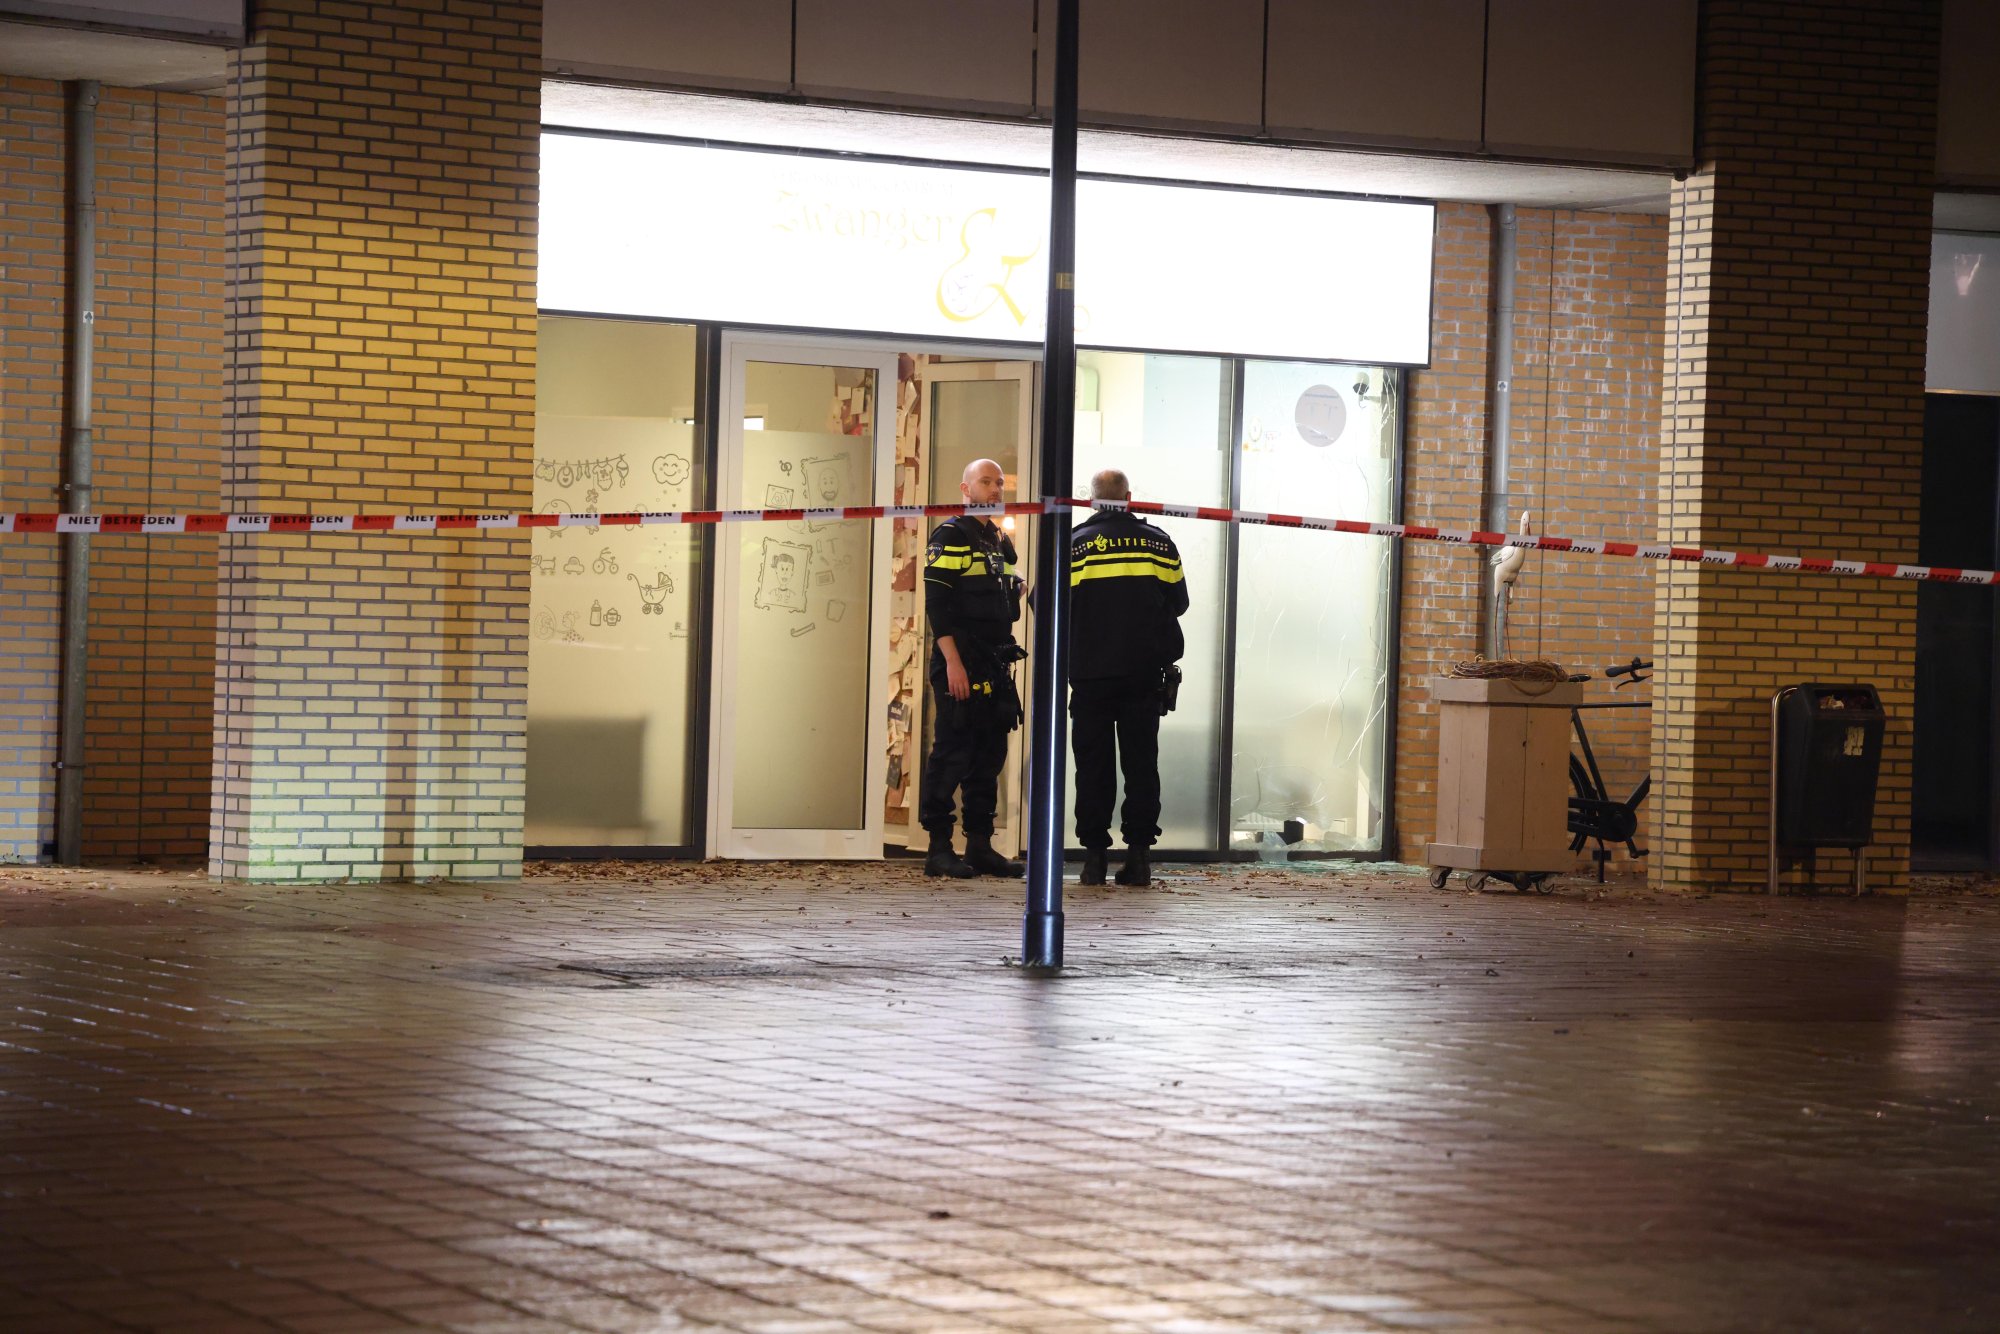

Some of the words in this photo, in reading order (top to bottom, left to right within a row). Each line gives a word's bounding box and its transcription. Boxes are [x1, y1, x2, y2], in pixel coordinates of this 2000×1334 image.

[1100, 504, 1127, 512] NIET
[68, 516, 99, 525] NIET
[104, 516, 175, 525] BETREDEN
[238, 516, 268, 524] NIET
[273, 516, 344, 524] BETREDEN
[1376, 529, 1402, 537] NIET
[1404, 532, 1462, 542] BETREDEN
[1087, 534, 1147, 551] POLITIE
[1510, 541, 1536, 549] NIET
[1539, 543, 1595, 554] BETREDEN
[1642, 552, 1668, 560] NIET
[1670, 554, 1726, 564] BETREDEN
[1801, 564, 1856, 574] BETREDEN
[1902, 571, 1927, 579] NIET
